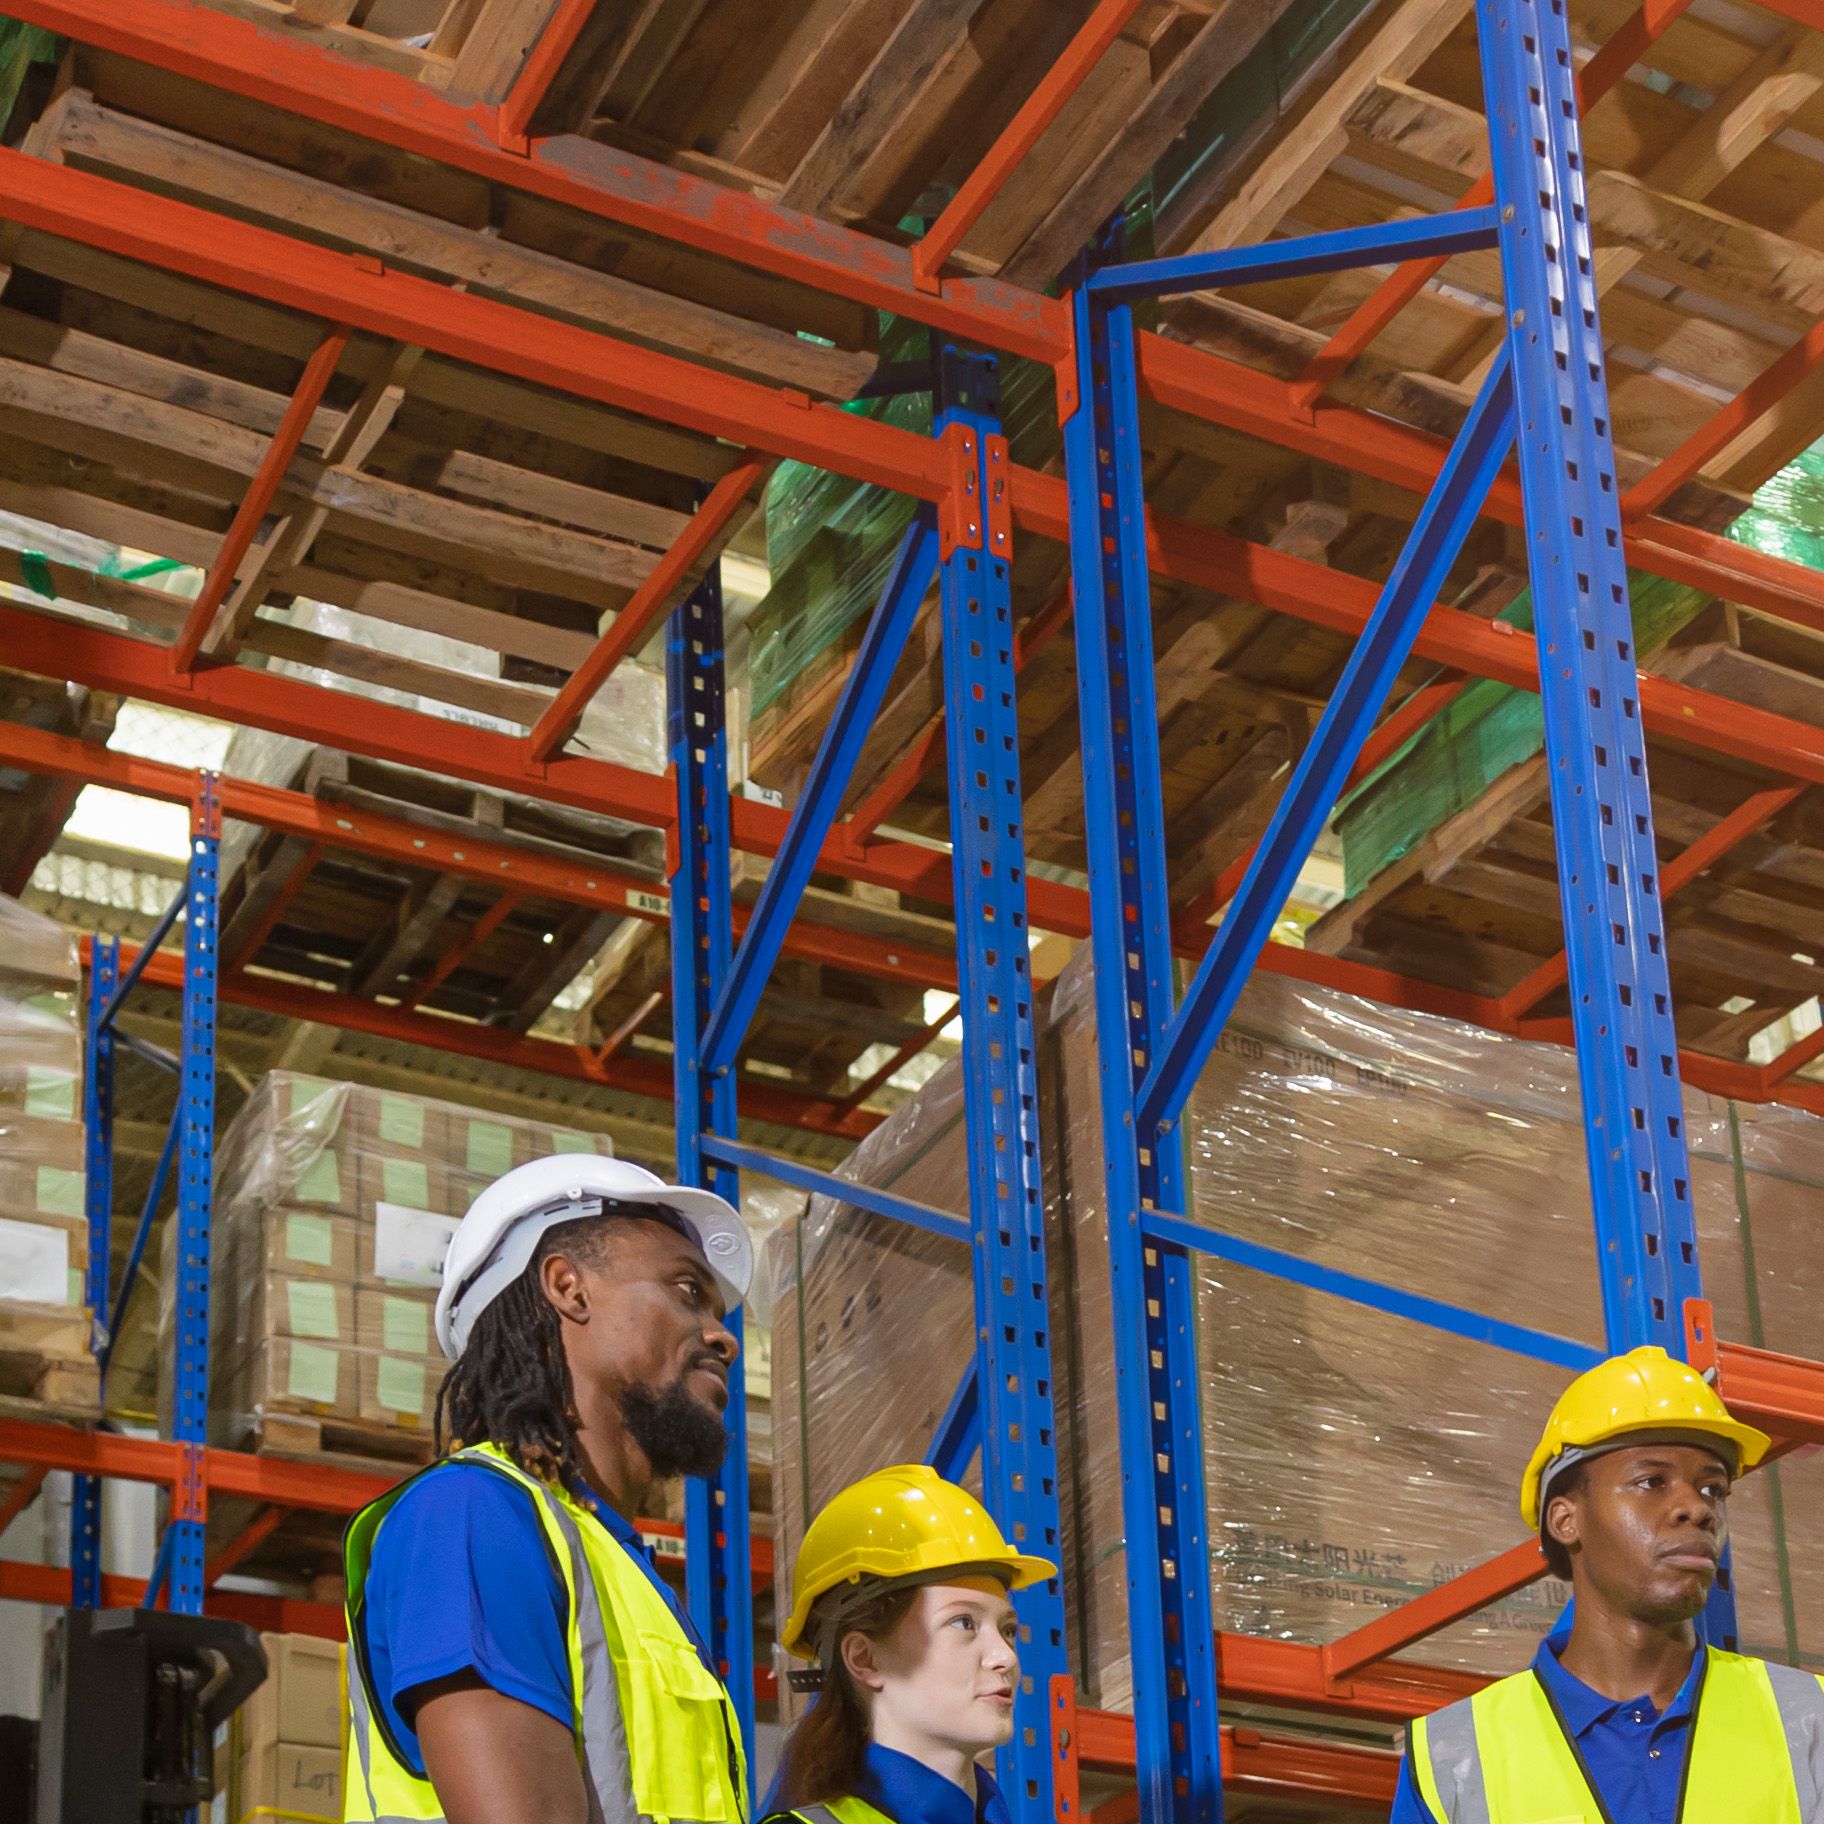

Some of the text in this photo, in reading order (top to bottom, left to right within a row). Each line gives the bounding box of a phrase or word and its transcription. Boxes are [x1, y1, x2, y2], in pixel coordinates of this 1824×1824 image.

[639, 893, 670, 912] A10-
[1314, 1580, 1411, 1608] Solar Ener
